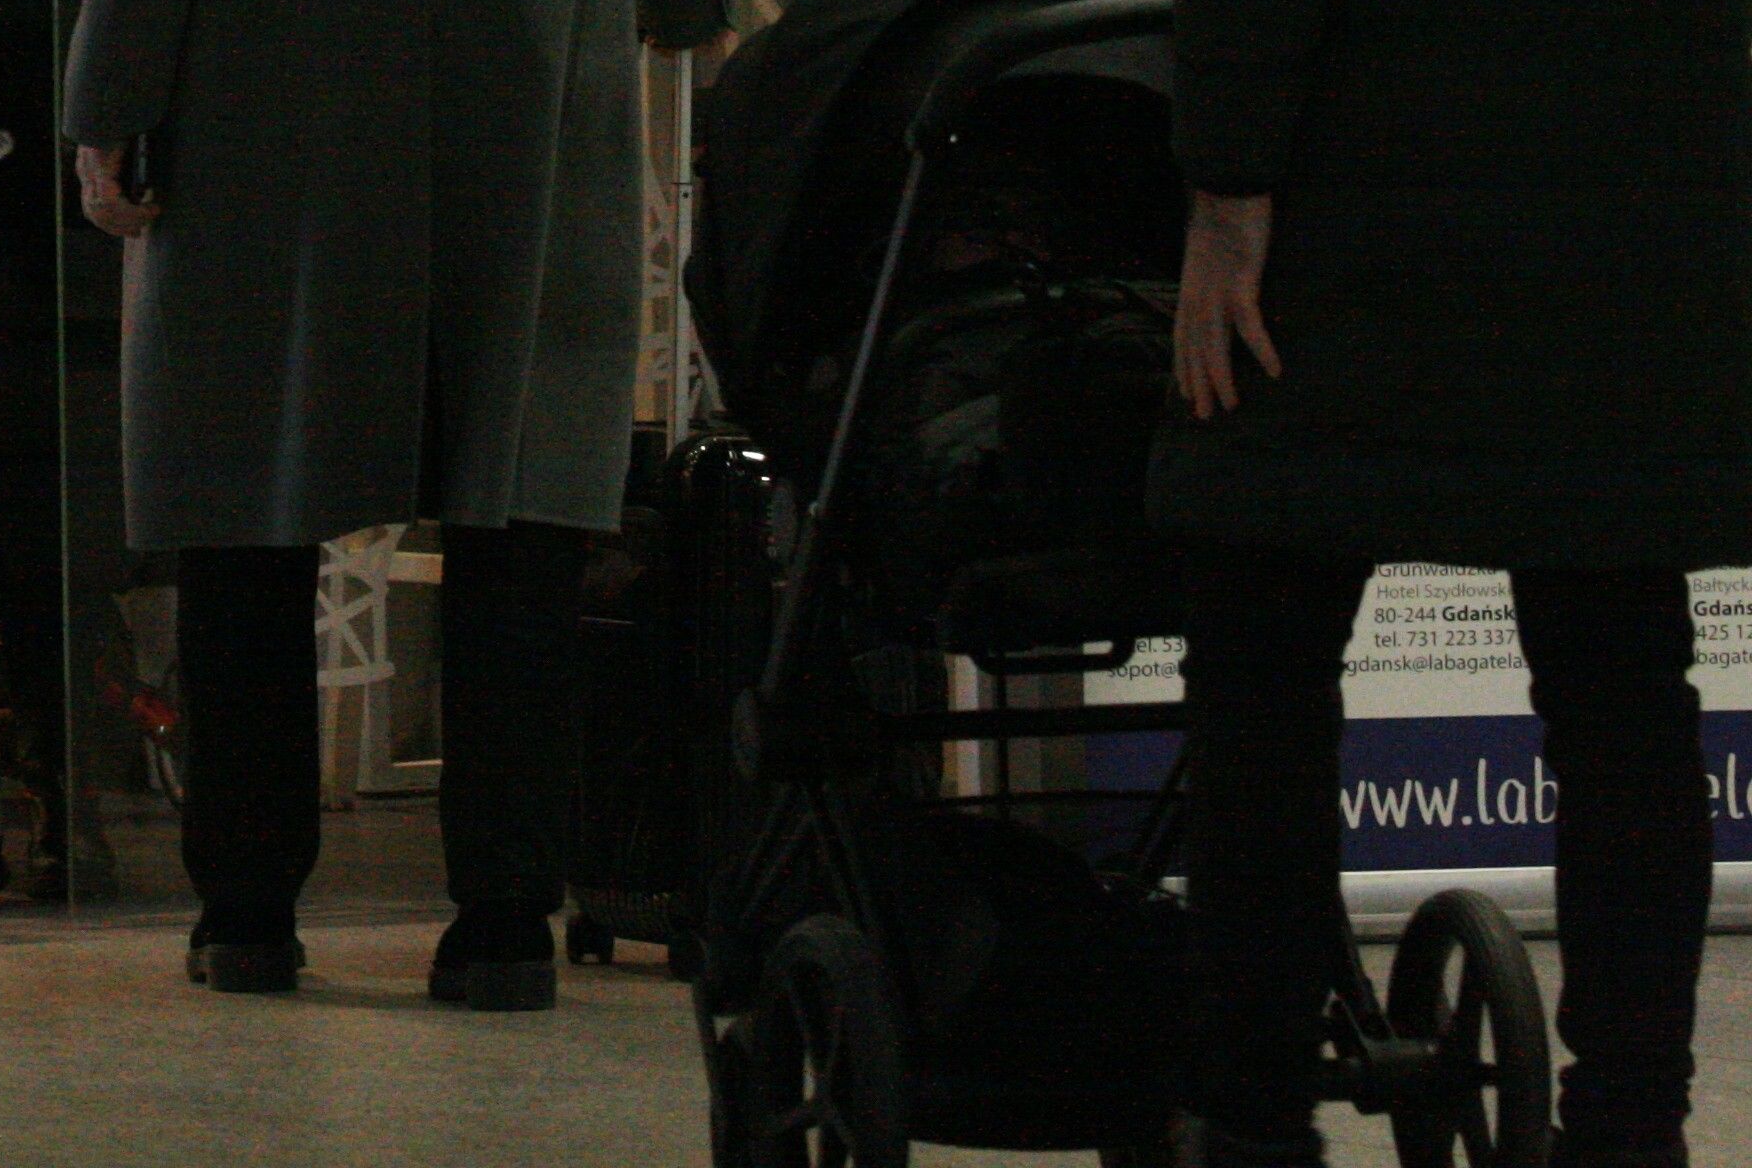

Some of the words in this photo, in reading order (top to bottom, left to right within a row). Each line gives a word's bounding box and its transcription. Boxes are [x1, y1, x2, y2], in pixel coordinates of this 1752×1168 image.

[1377, 585, 1419, 600] Hotel
[1424, 582, 1512, 601] Szydłowsk
[1693, 576, 1752, 595] Bałtyck
[1374, 607, 1436, 624] 80-244
[1442, 603, 1516, 622] Gdańsk
[1374, 633, 1401, 648] tel.
[1407, 631, 1436, 647] 731
[1445, 630, 1477, 646] 223
[1483, 629, 1519, 645] 337
